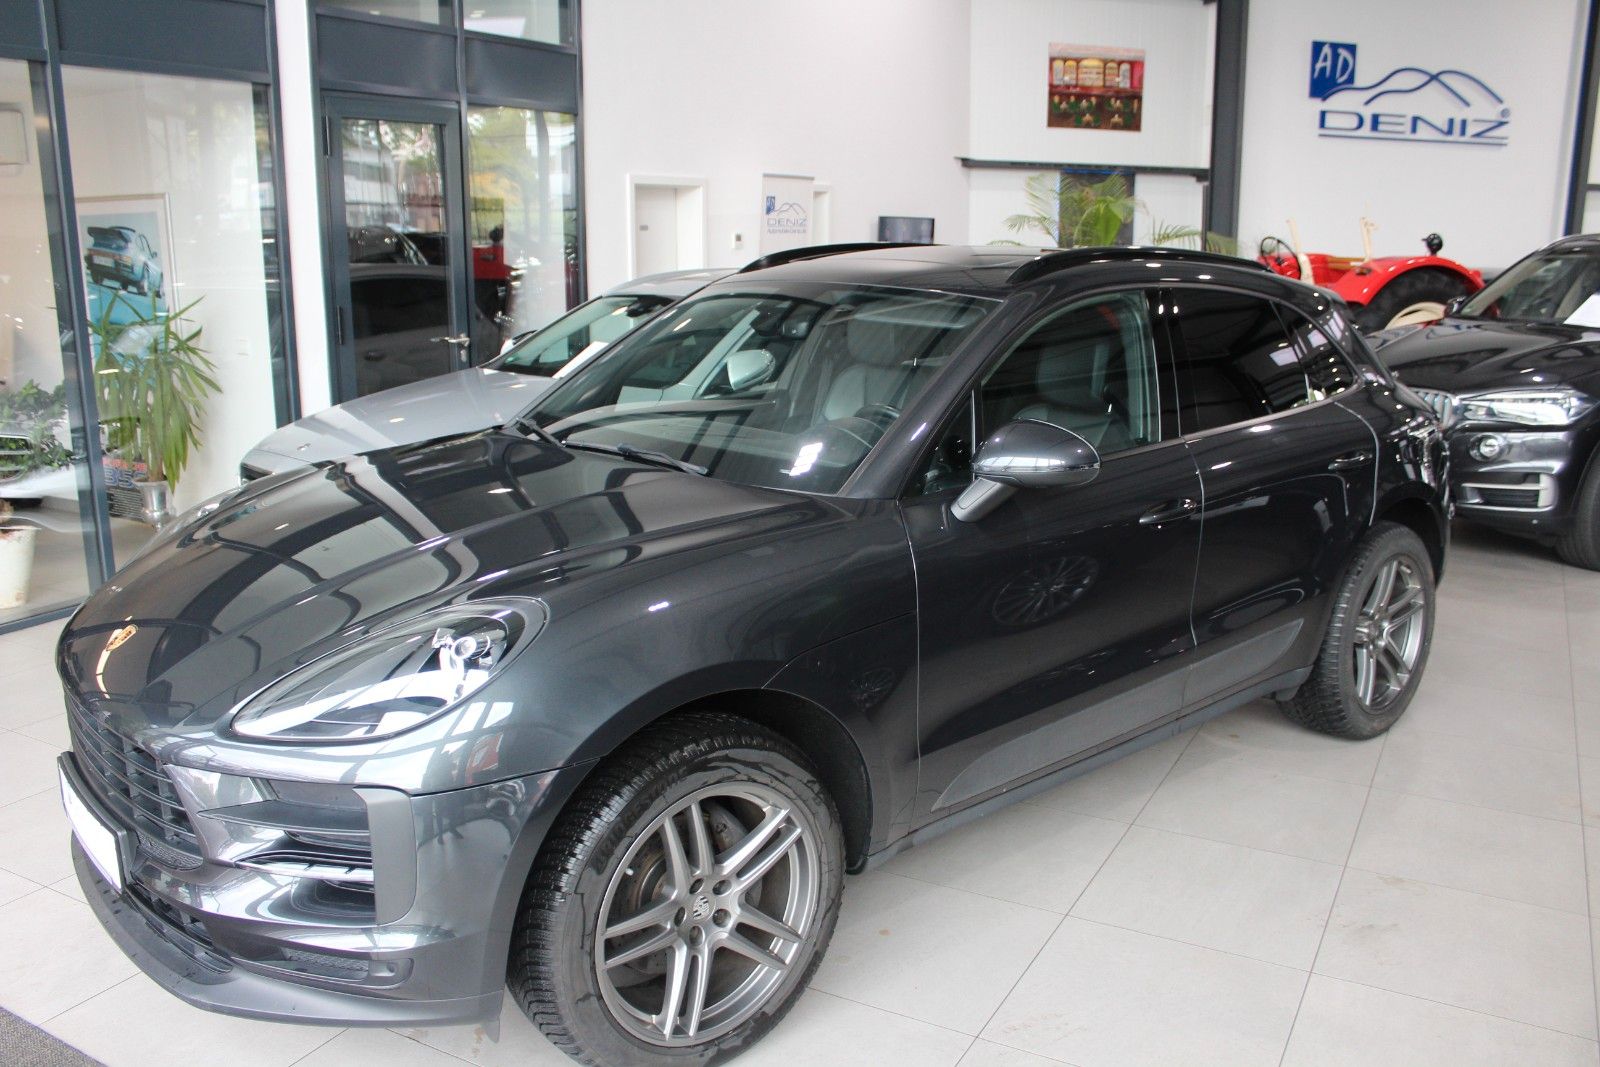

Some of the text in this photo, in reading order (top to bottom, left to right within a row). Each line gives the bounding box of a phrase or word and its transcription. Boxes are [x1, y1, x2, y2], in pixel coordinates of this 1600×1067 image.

[1313, 43, 1354, 83] AD
[1318, 110, 1510, 139] DENIZ
[767, 217, 808, 227] DENIZ
